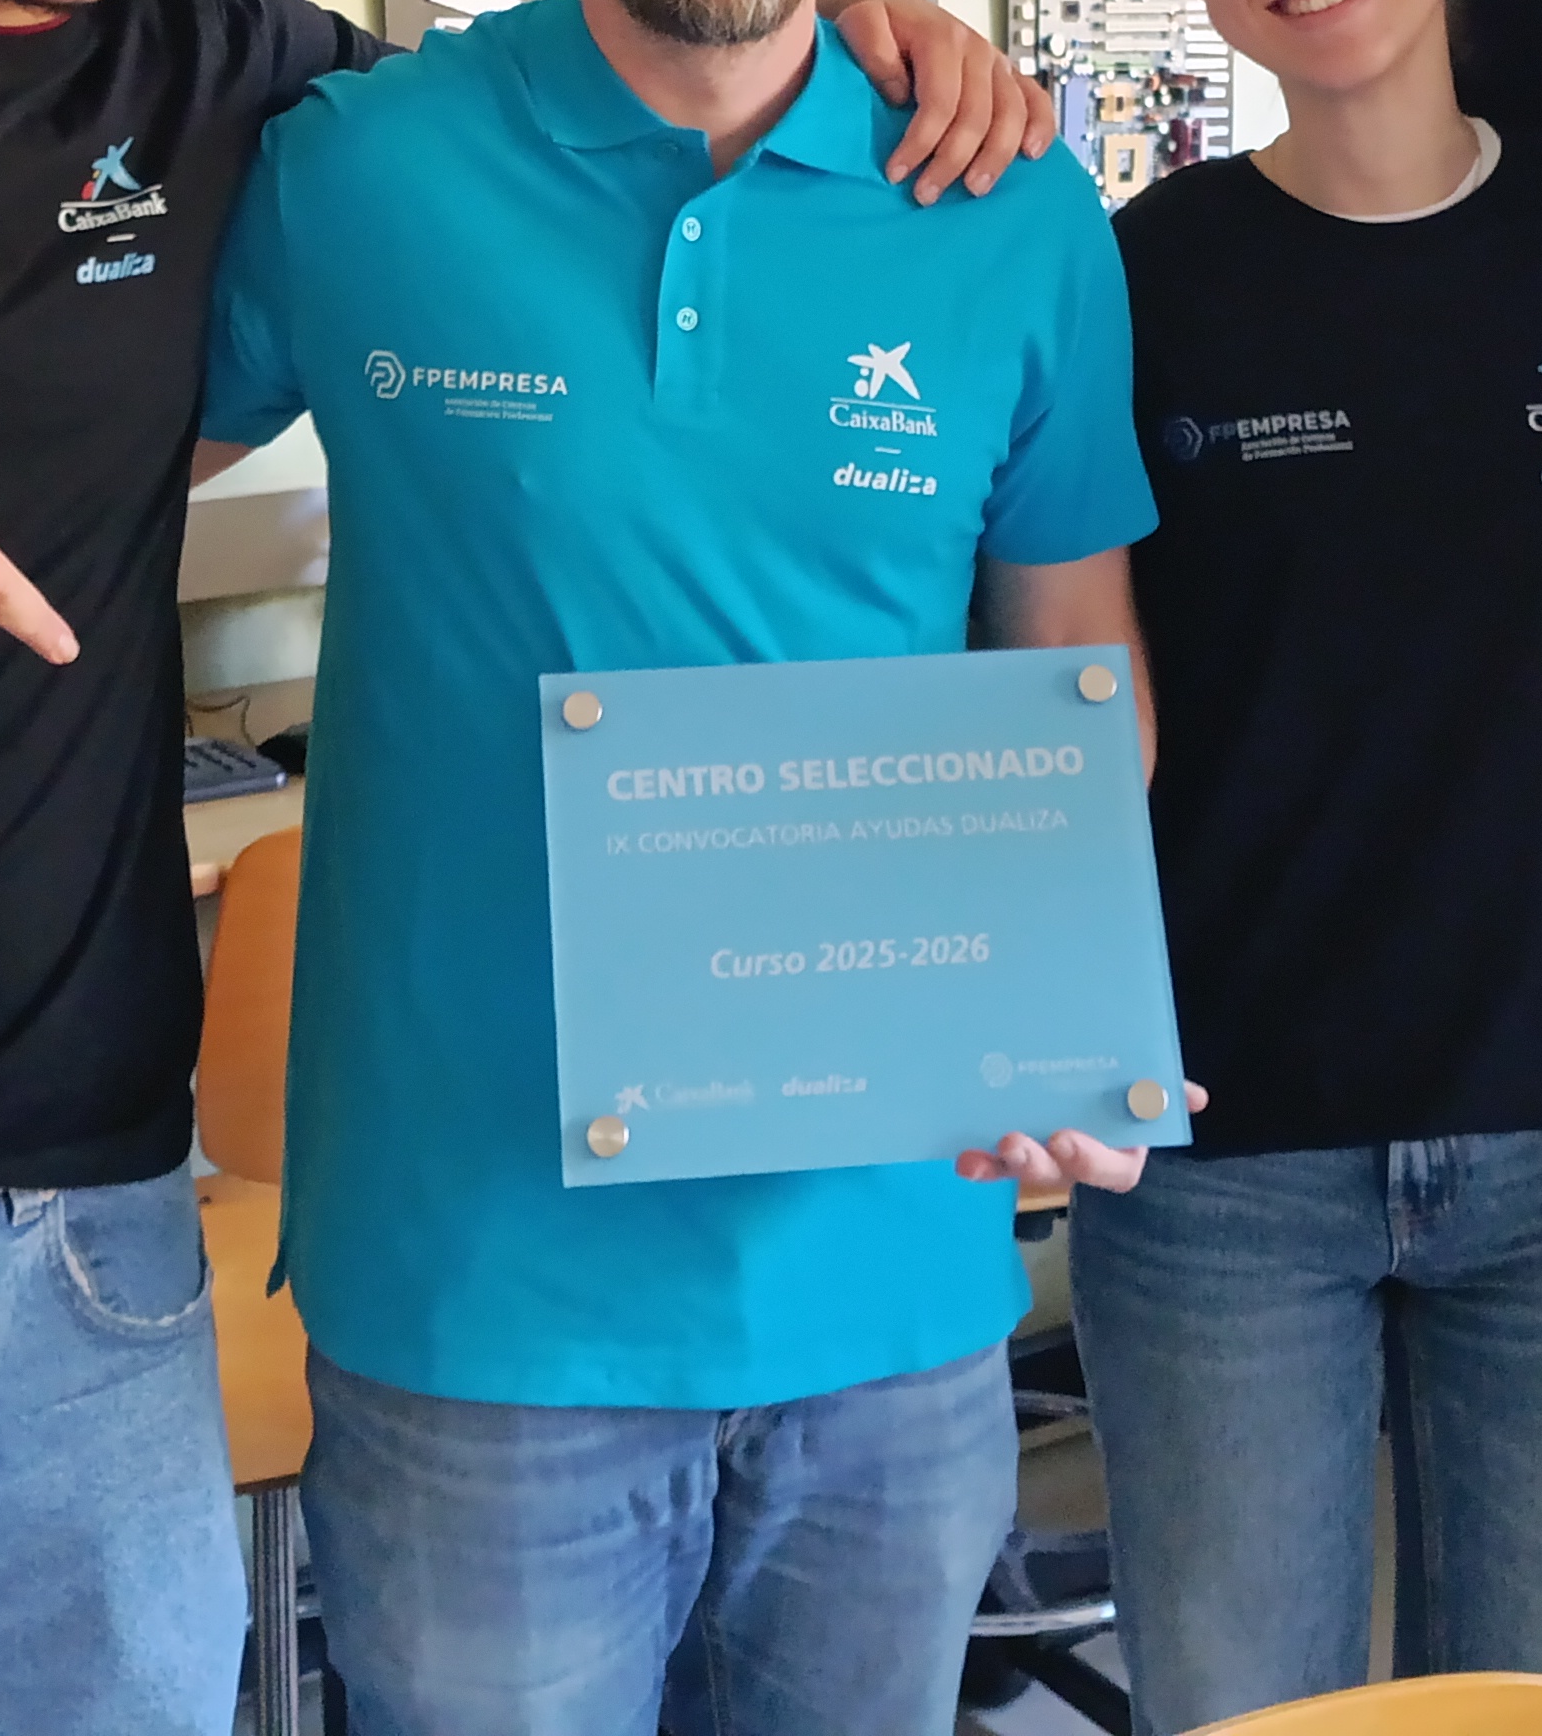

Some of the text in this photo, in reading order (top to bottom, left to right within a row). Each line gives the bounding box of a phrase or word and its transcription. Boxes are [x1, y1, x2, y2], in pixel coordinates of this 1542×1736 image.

[57, 191, 169, 233] CaixaBank
[412, 366, 568, 396] FPEMPRESA
[829, 403, 938, 437] CaixaBank
[606, 745, 1084, 801] CENTRO SELECCIONADO
[606, 834, 630, 856] IX
[637, 821, 842, 854] CONVOCATORIA
[850, 816, 954, 841] AYUDAS
[710, 933, 990, 979] Curso 2025-2026
